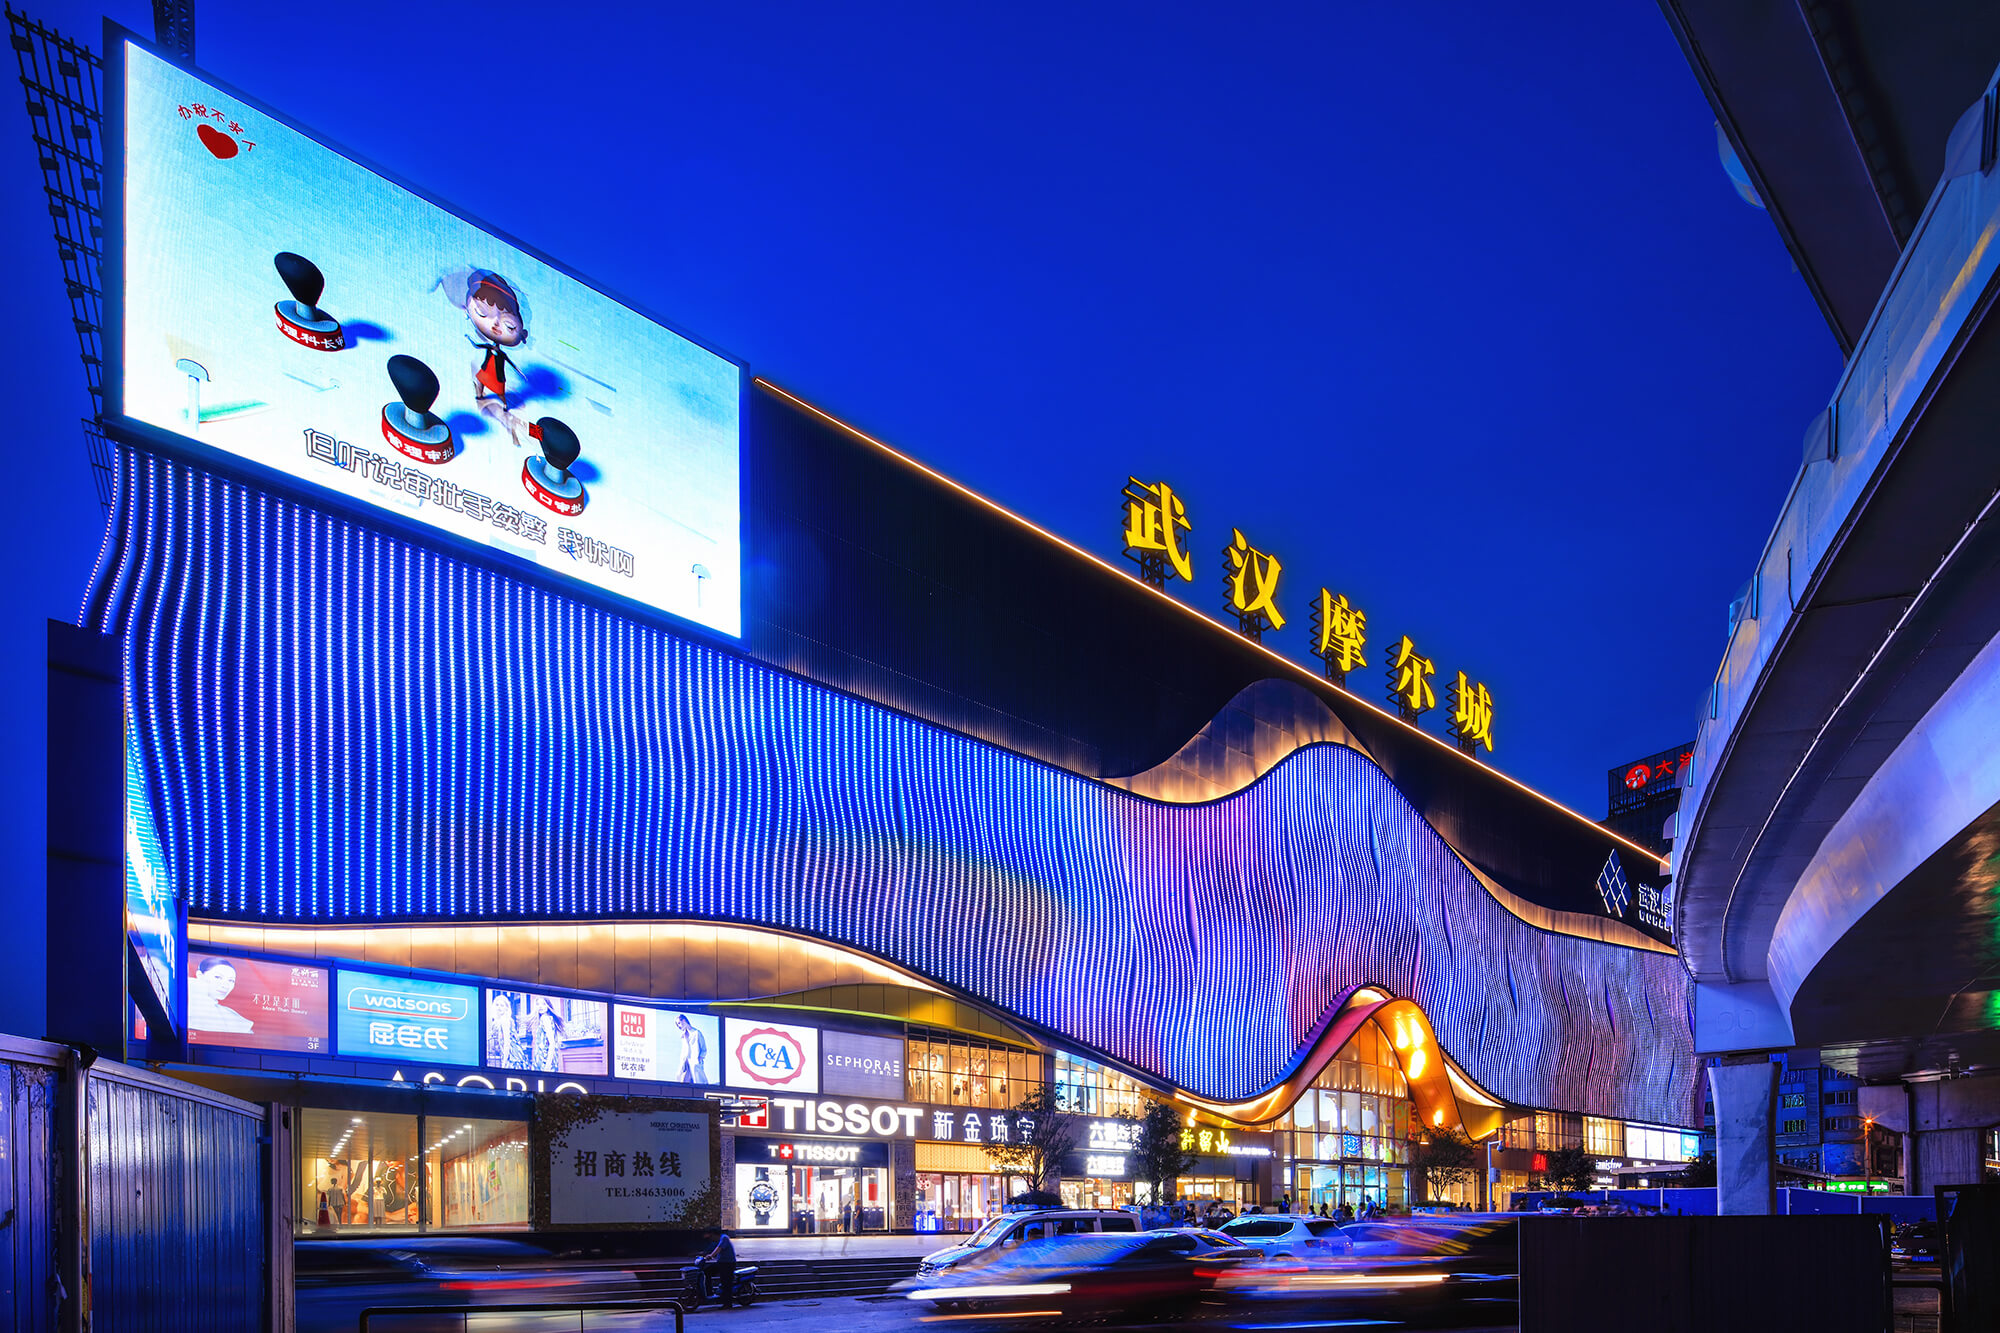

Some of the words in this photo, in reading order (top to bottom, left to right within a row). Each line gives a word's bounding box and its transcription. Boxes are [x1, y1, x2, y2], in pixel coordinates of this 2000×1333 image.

[304, 428, 548, 545] 但听说审批手续繁
[1122, 476, 1493, 752] 武汉摩尔城
[364, 994, 452, 1014] watsons
[623, 1014, 641, 1025] UNI
[369, 1022, 449, 1050] 屈臣氏
[623, 1025, 643, 1035] QLO
[307, 1042, 320, 1050] 3F
[749, 1042, 794, 1070] C&A
[621, 1062, 646, 1072] 优衣库
[827, 1054, 891, 1071] SEPHORA
[774, 1098, 923, 1137] TISSOT
[1180, 1128, 1230, 1154] 許留山
[768, 1145, 778, 1157] T
[794, 1145, 860, 1161] TISSOT
[574, 1150, 682, 1177] 招商热线
[605, 1187, 685, 1197] TEL:84633006
